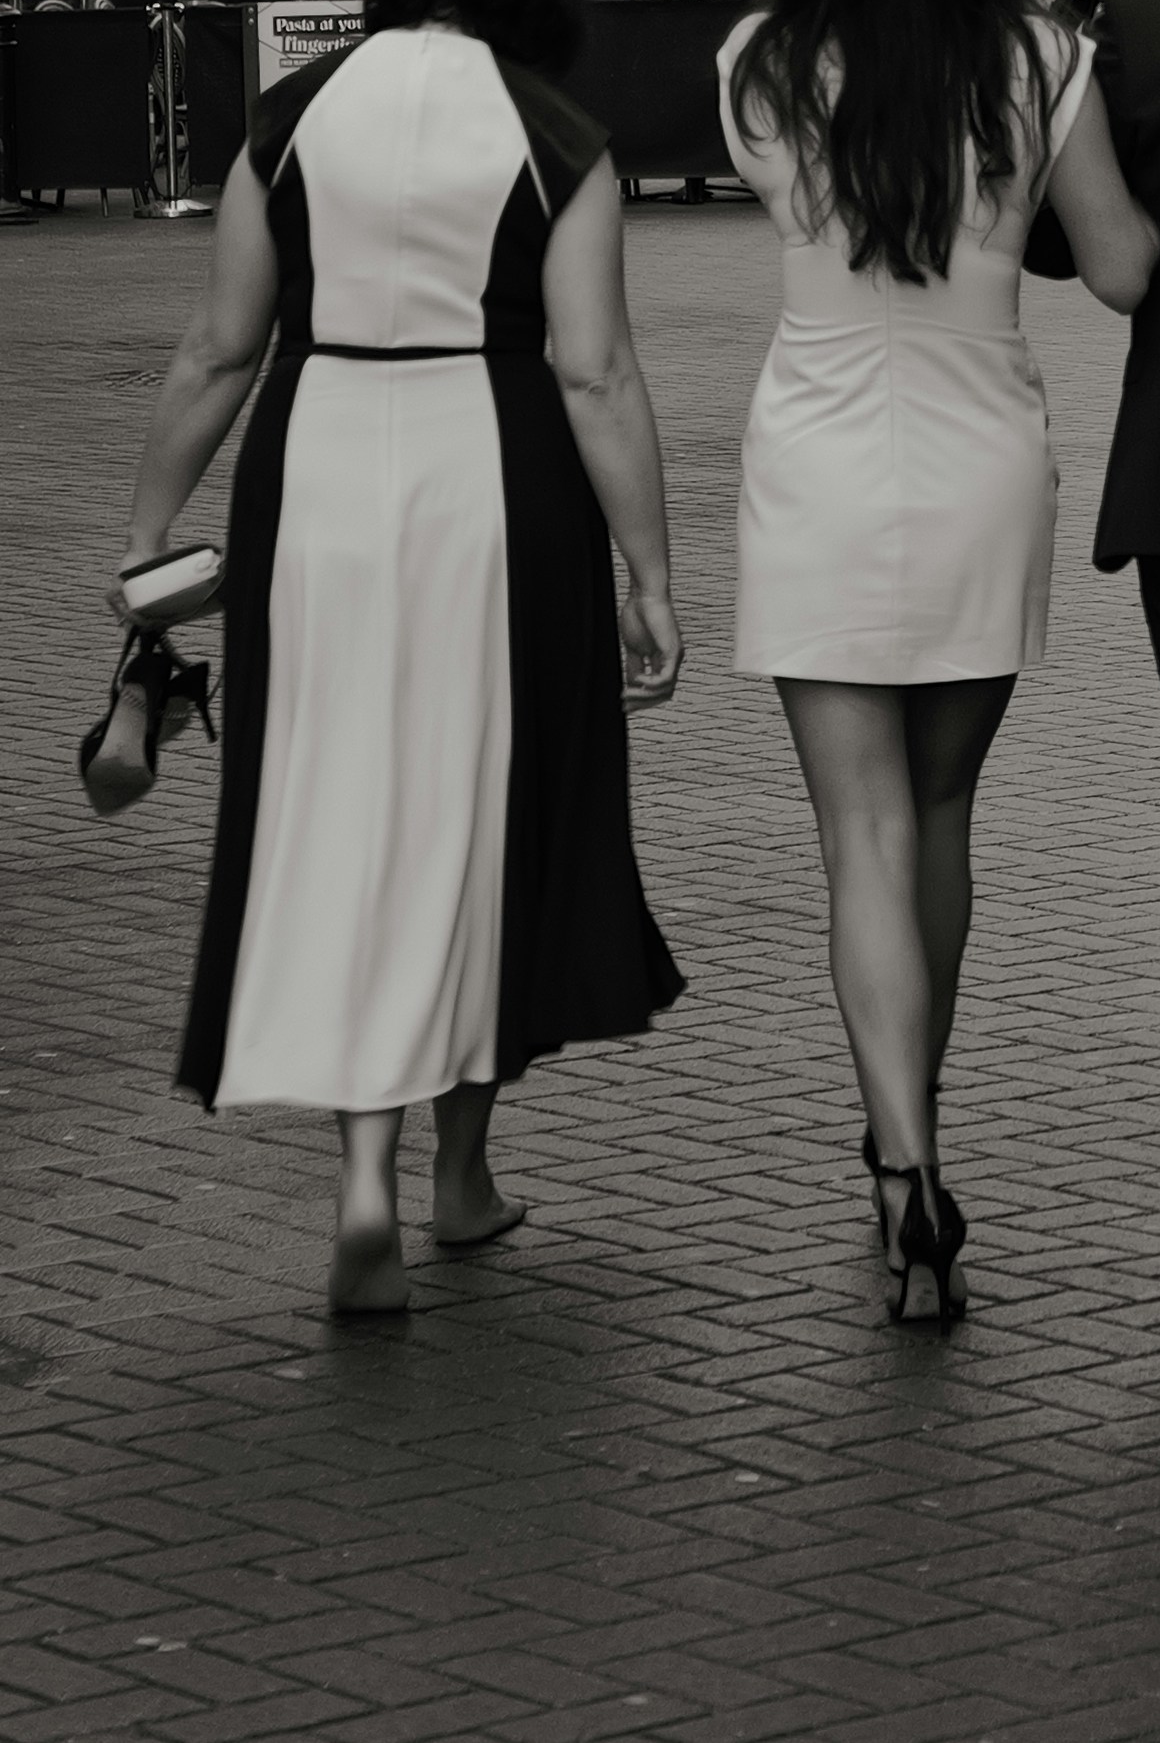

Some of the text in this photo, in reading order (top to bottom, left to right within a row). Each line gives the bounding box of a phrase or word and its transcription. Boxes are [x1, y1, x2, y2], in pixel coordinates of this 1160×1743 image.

[276, 18, 365, 32] Pasta at you
[284, 35, 354, 54] fingerti
